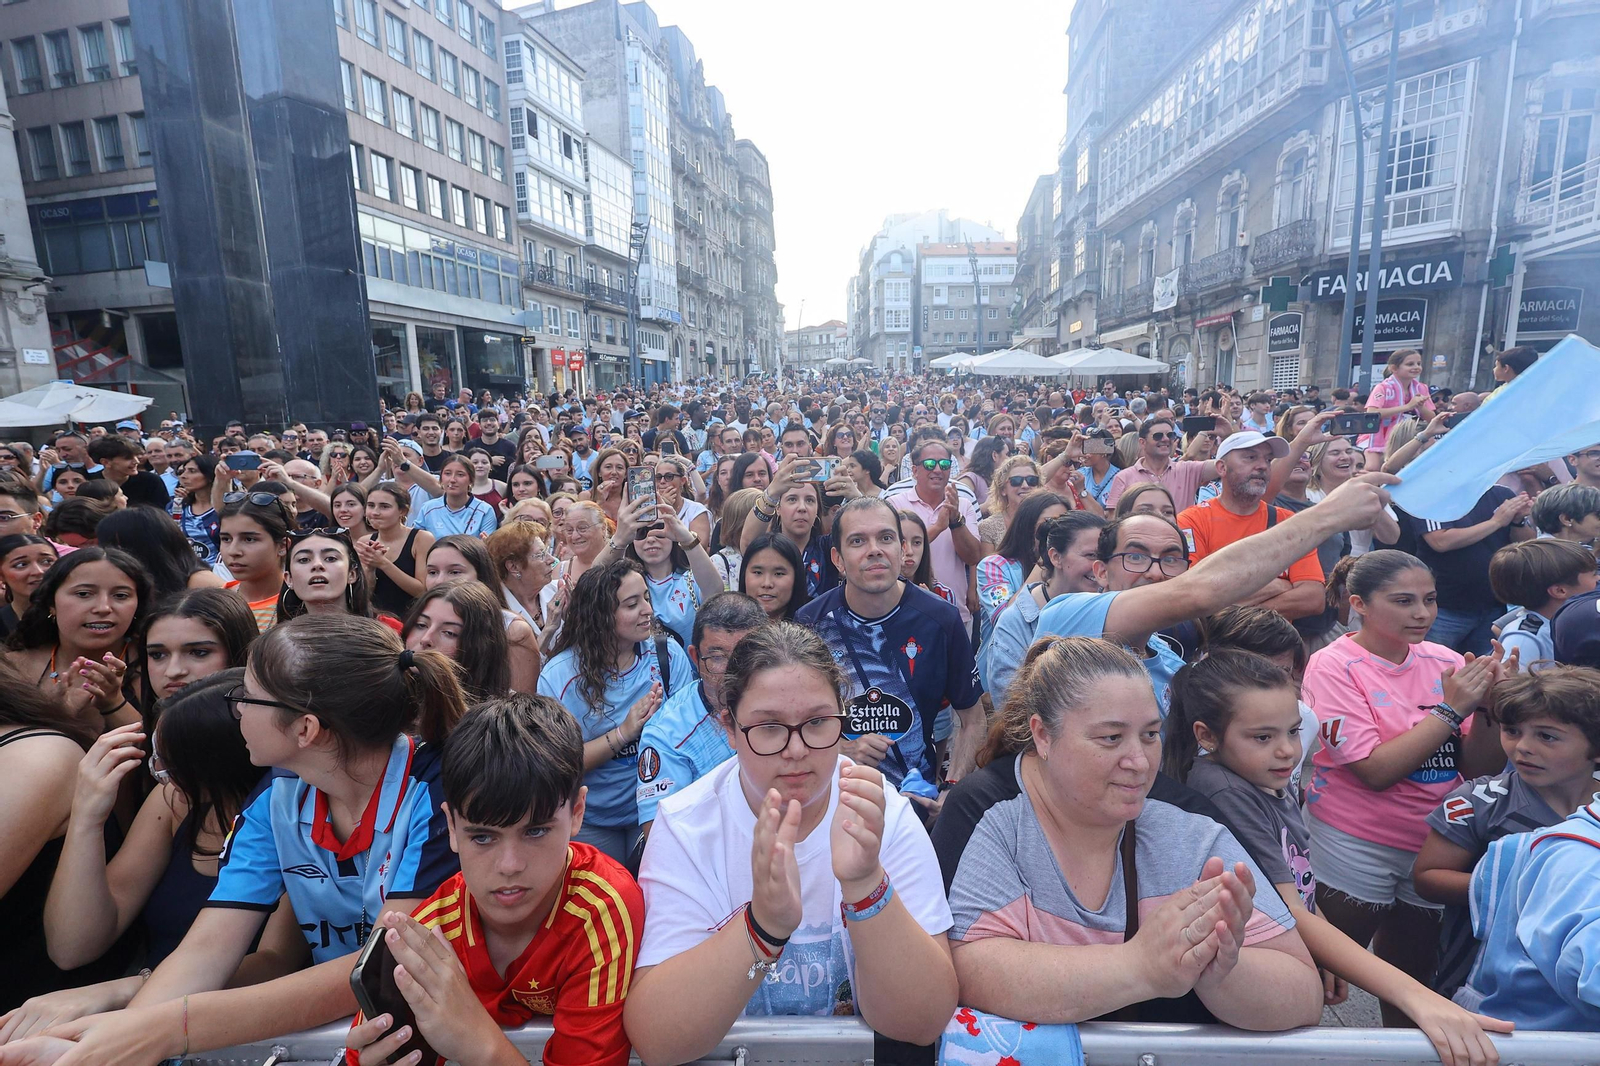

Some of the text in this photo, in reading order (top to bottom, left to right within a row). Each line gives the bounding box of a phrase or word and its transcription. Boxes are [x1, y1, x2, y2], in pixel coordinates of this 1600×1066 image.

[41, 207, 69, 219] OCASO
[457, 247, 477, 259] OCASO
[1519, 299, 1576, 312] ARMACIA
[1270, 324, 1299, 337] FARMACIA
[850, 704, 900, 718] Estrella
[851, 717, 898, 732] Galicia
[794, 951, 818, 962] ITALY
